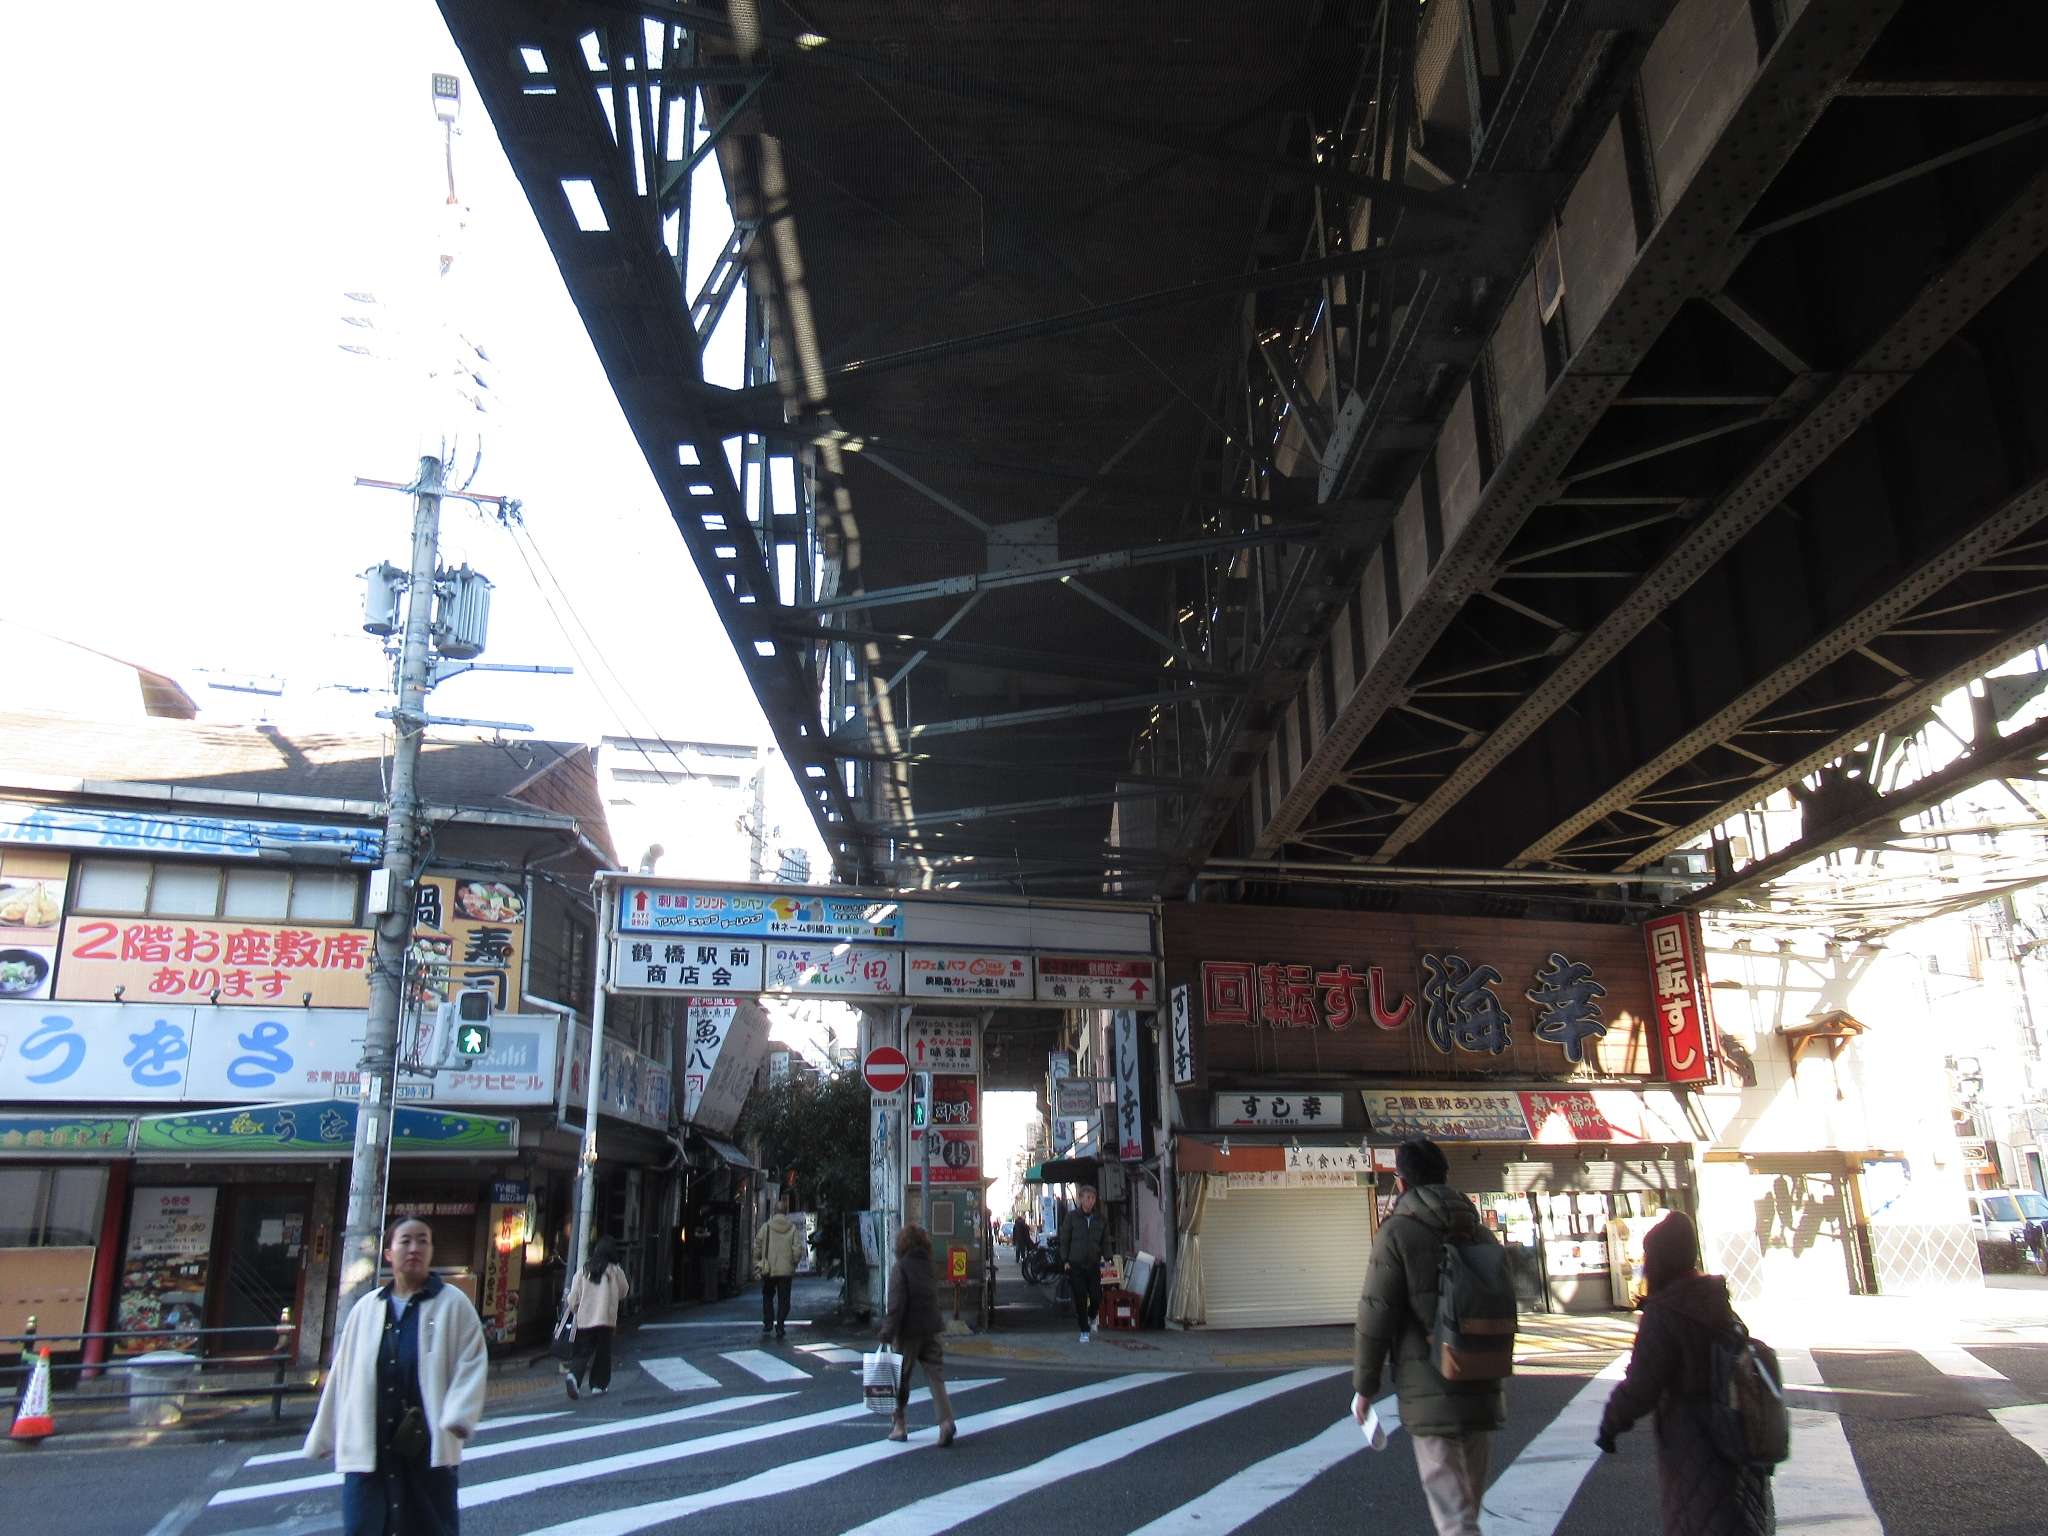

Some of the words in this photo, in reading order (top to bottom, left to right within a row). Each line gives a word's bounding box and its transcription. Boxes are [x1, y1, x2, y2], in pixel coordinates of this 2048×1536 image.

[71, 921, 371, 971] 2階お座敷席
[631, 943, 750, 967] 鶴橋駅前
[776, 950, 811, 961] のんで
[148, 966, 294, 999] あります
[647, 965, 733, 986] 商店会
[1202, 960, 1415, 1031] 回転すし
[1652, 924, 1696, 1072] 回転すし
[474, 1042, 528, 1066] sahi
[450, 1073, 543, 1090] アサヒビール
[1242, 1096, 1322, 1120] すし幸
[1289, 1153, 1371, 1169] 立ち食い寿司
